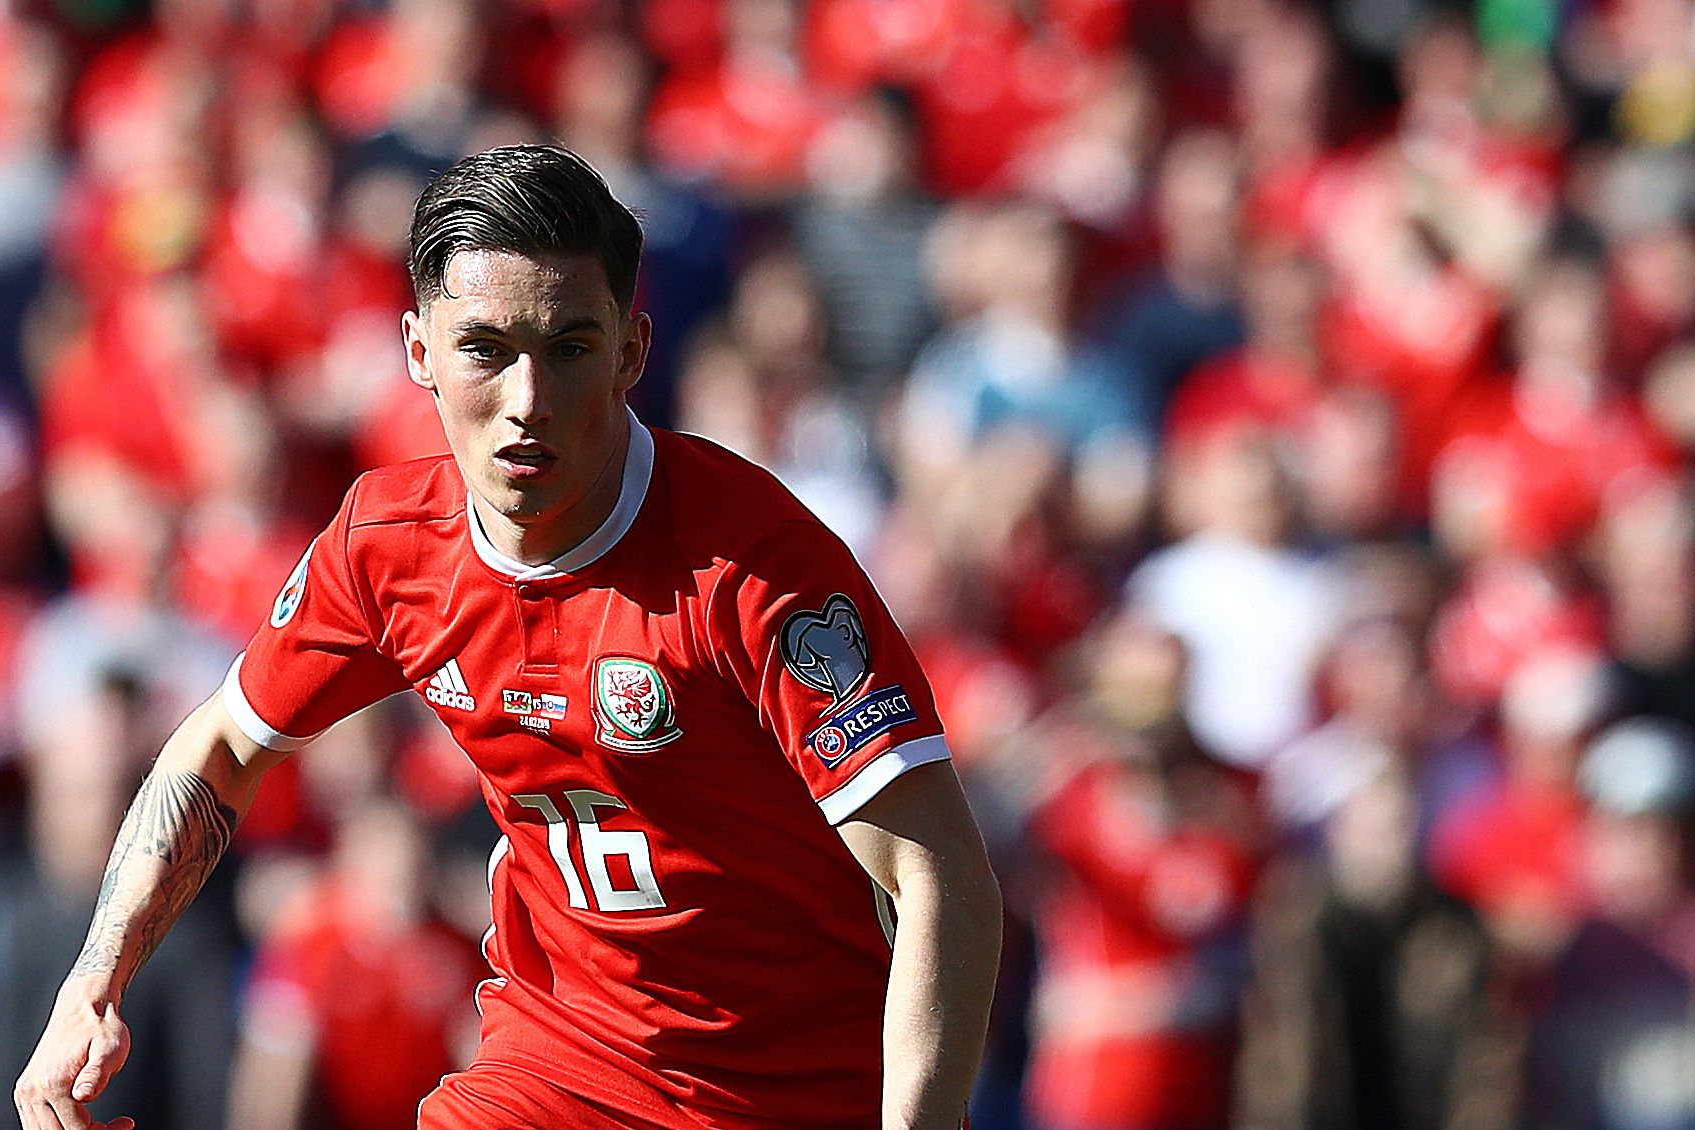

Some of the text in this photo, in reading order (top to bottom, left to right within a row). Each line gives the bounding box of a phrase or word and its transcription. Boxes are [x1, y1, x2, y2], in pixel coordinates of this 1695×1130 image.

[425, 687, 475, 711] adidas
[843, 694, 911, 738] RESPECT
[510, 789, 667, 912] 16
